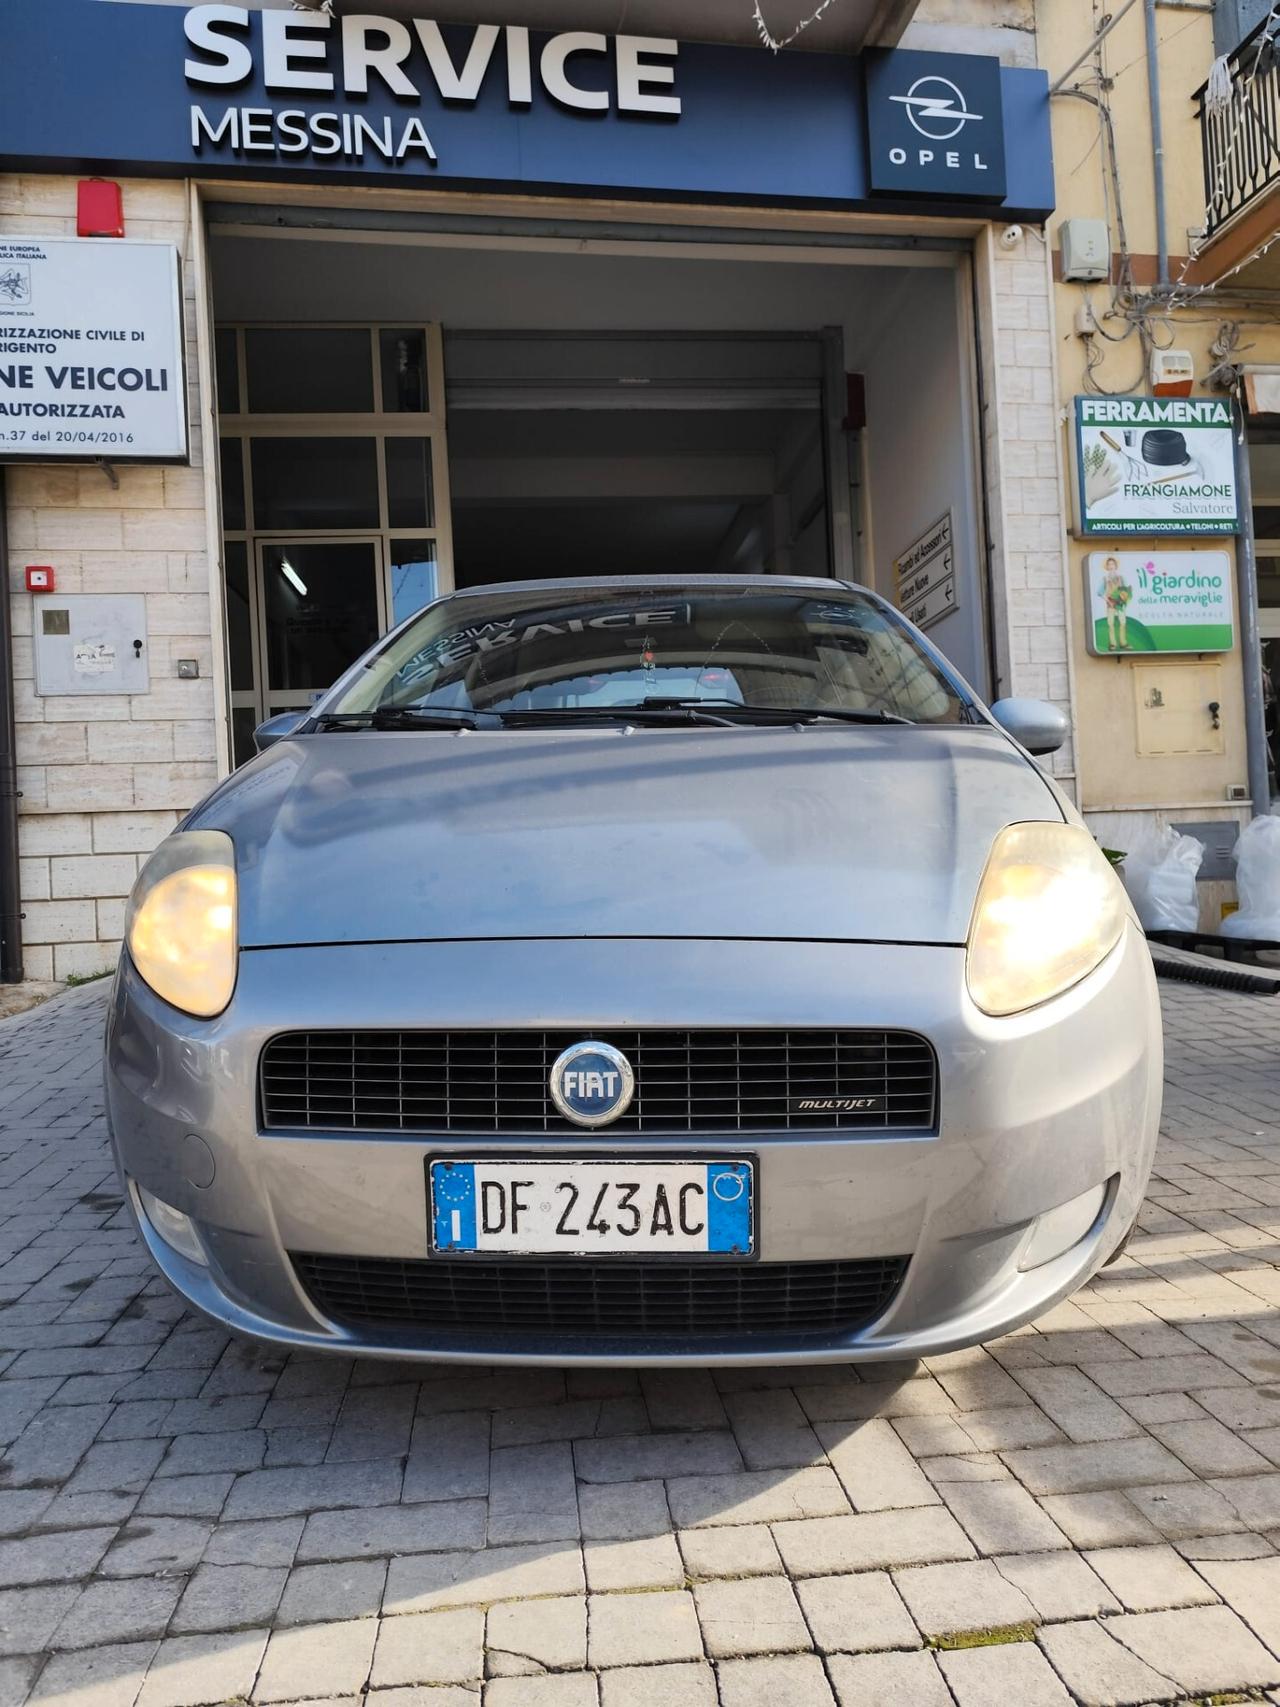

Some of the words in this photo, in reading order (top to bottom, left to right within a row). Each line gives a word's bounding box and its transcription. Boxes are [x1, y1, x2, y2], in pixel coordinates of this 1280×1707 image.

[183, 4, 682, 115] SERVICE
[190, 105, 438, 162] MESSINA
[888, 147, 988, 170] OPEL
[86, 330, 126, 341] CIVILE
[131, 331, 145, 342] DI
[0, 365, 34, 389] NE
[45, 366, 168, 392] VEICOLI
[0, 402, 126, 418] AUTORIZZATA
[1082, 400, 1230, 423] FERRAMENTA
[32, 430, 50, 441] del
[56, 431, 134, 443] 20/04/2016
[1123, 484, 1232, 497] FRANGIAMONE
[1172, 502, 1233, 515] Salvatore
[1092, 522, 1122, 531] ARTICOLI
[1123, 522, 1136, 531] PER
[1191, 522, 1215, 531] TELONI
[1219, 522, 1233, 531] RETI
[1136, 568, 1147, 588] il
[1152, 569, 1222, 595] giardino
[1160, 592, 1223, 607] meraviglie
[564, 1071, 619, 1098] FIAT
[798, 1099, 876, 1110] MULTIJET
